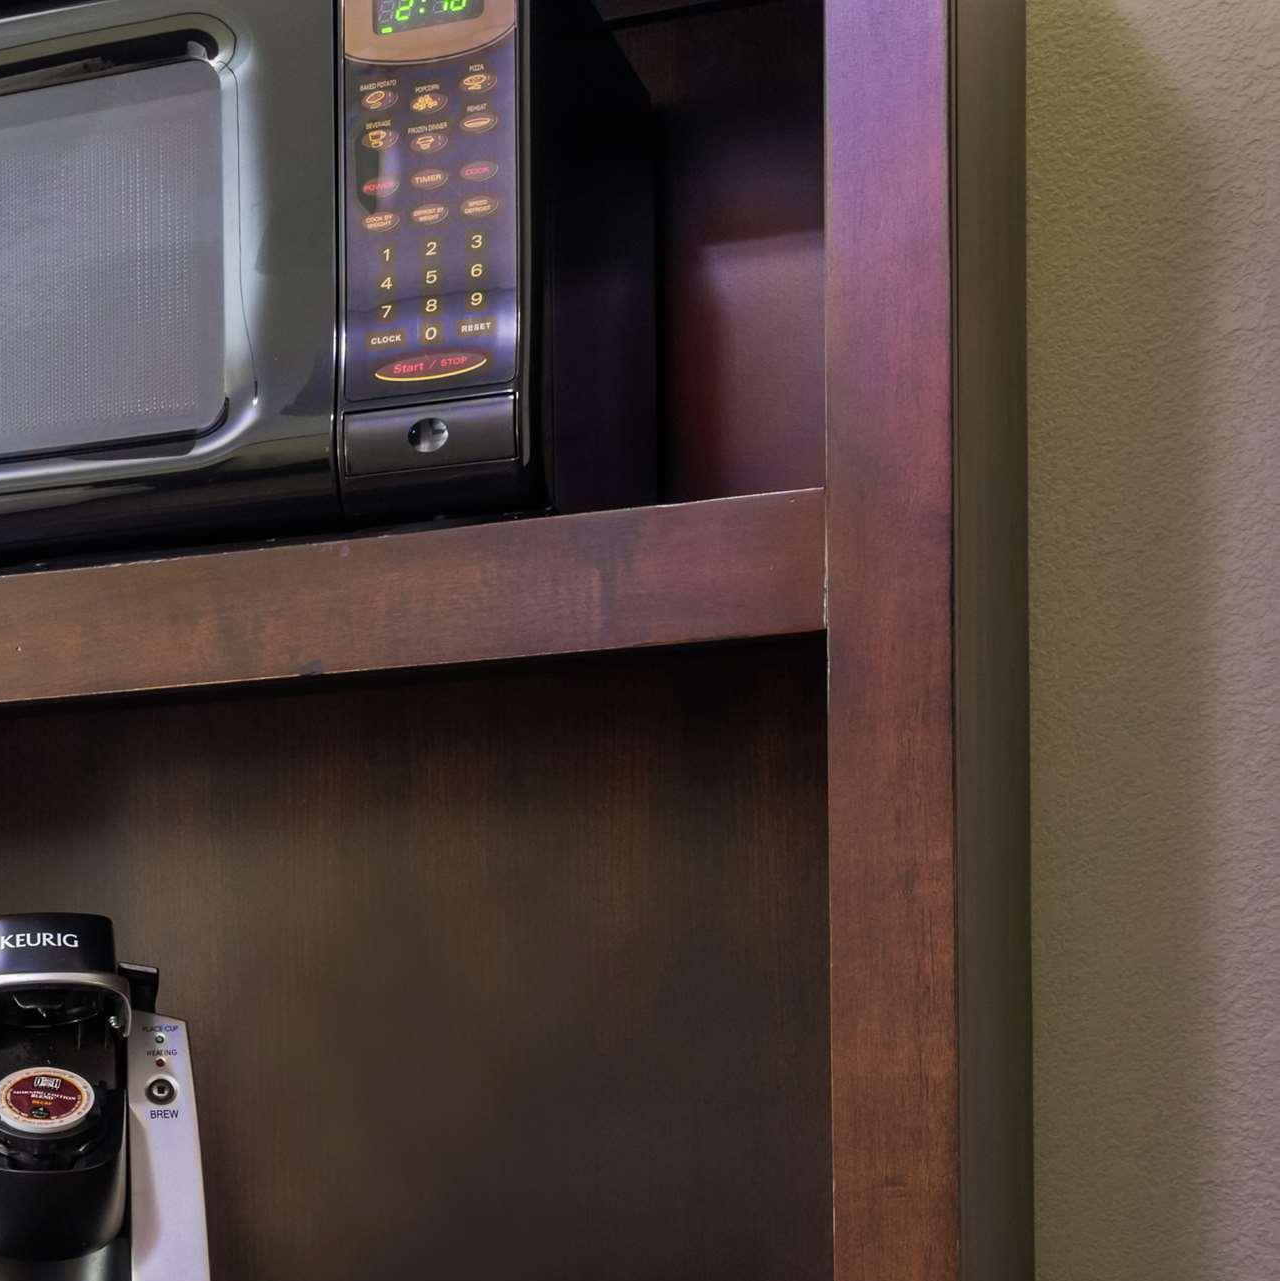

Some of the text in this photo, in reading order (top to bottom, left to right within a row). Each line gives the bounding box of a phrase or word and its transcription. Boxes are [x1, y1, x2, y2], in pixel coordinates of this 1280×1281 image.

[415, 84, 440, 93] POPCORN
[415, 174, 441, 184] TIMER
[383, 235, 482, 261] 1 2 3
[381, 264, 483, 290] 4 5 6
[381, 292, 483, 319] 7 8 9
[370, 322, 491, 345] CLOCK 0 RESET
[393, 361, 424, 374] Start
[441, 356, 468, 367] STOP
[0, 932, 79, 950] KEURIG
[149, 1109, 179, 1119] BREW
